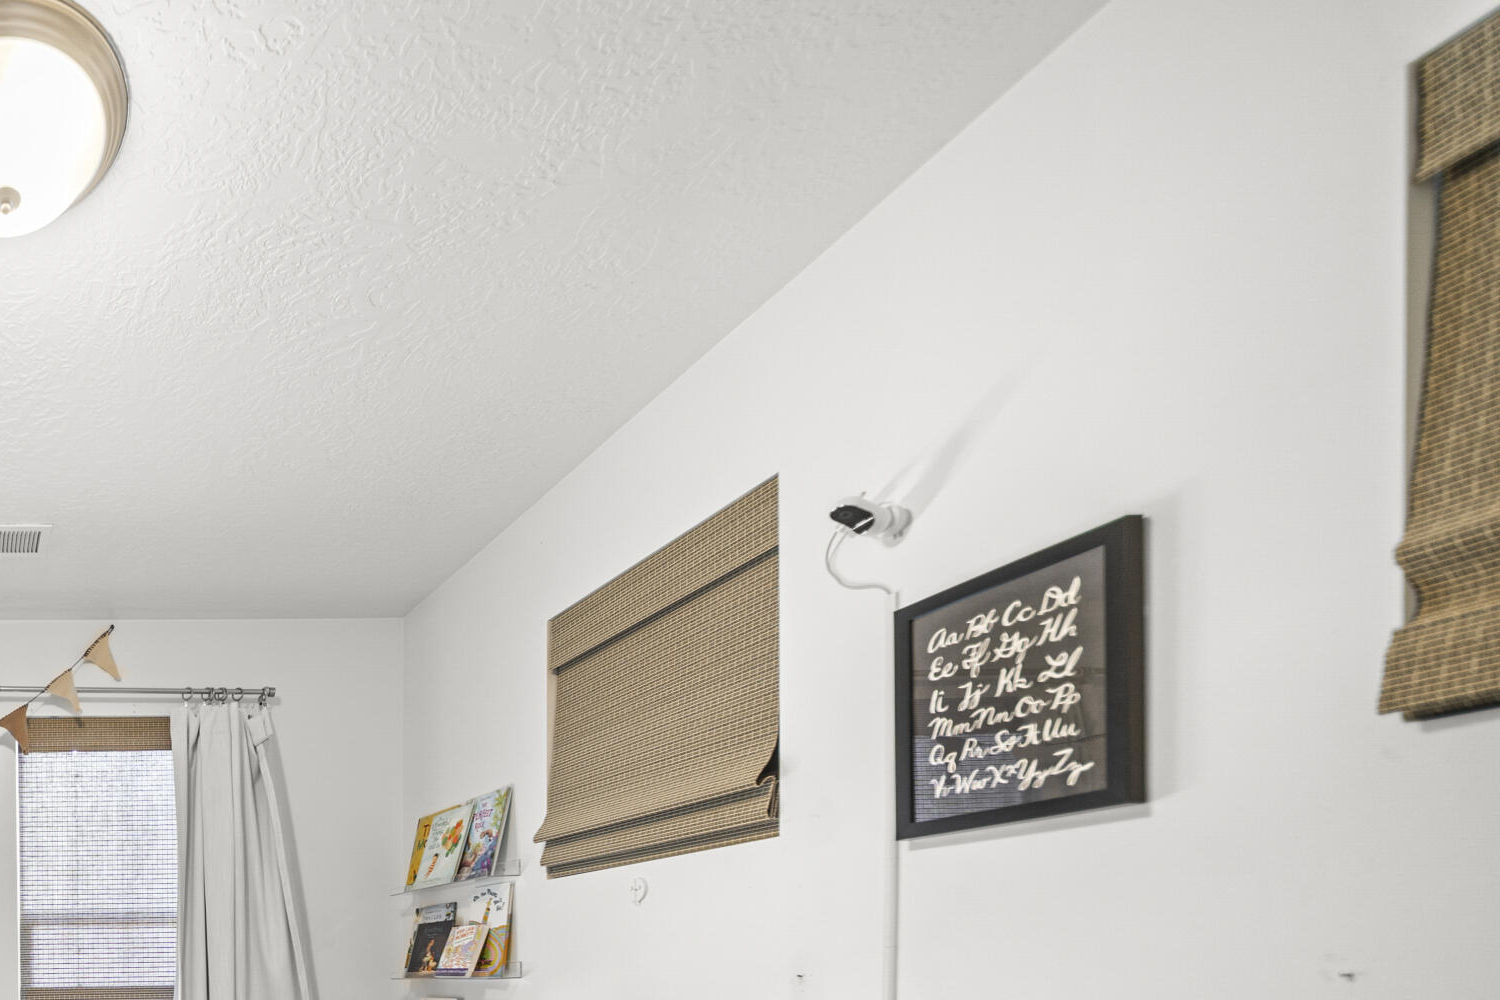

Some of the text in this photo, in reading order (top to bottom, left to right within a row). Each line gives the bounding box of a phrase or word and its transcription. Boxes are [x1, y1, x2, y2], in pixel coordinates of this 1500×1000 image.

[927, 628, 963, 653] Aa
[1001, 600, 1036, 627] Cc
[1038, 576, 1081, 616] Dd
[928, 657, 958, 681] Ee
[1036, 608, 1078, 646] Hh
[930, 646, 1083, 713] Ii Jj Kk Ll
[928, 683, 1081, 740] Mm Nn Oo Pp
[929, 745, 957, 773] Qq
[1043, 713, 1081, 742] Uu
[952, 772, 991, 793] Ww
[1016, 758, 1054, 790] Yy
